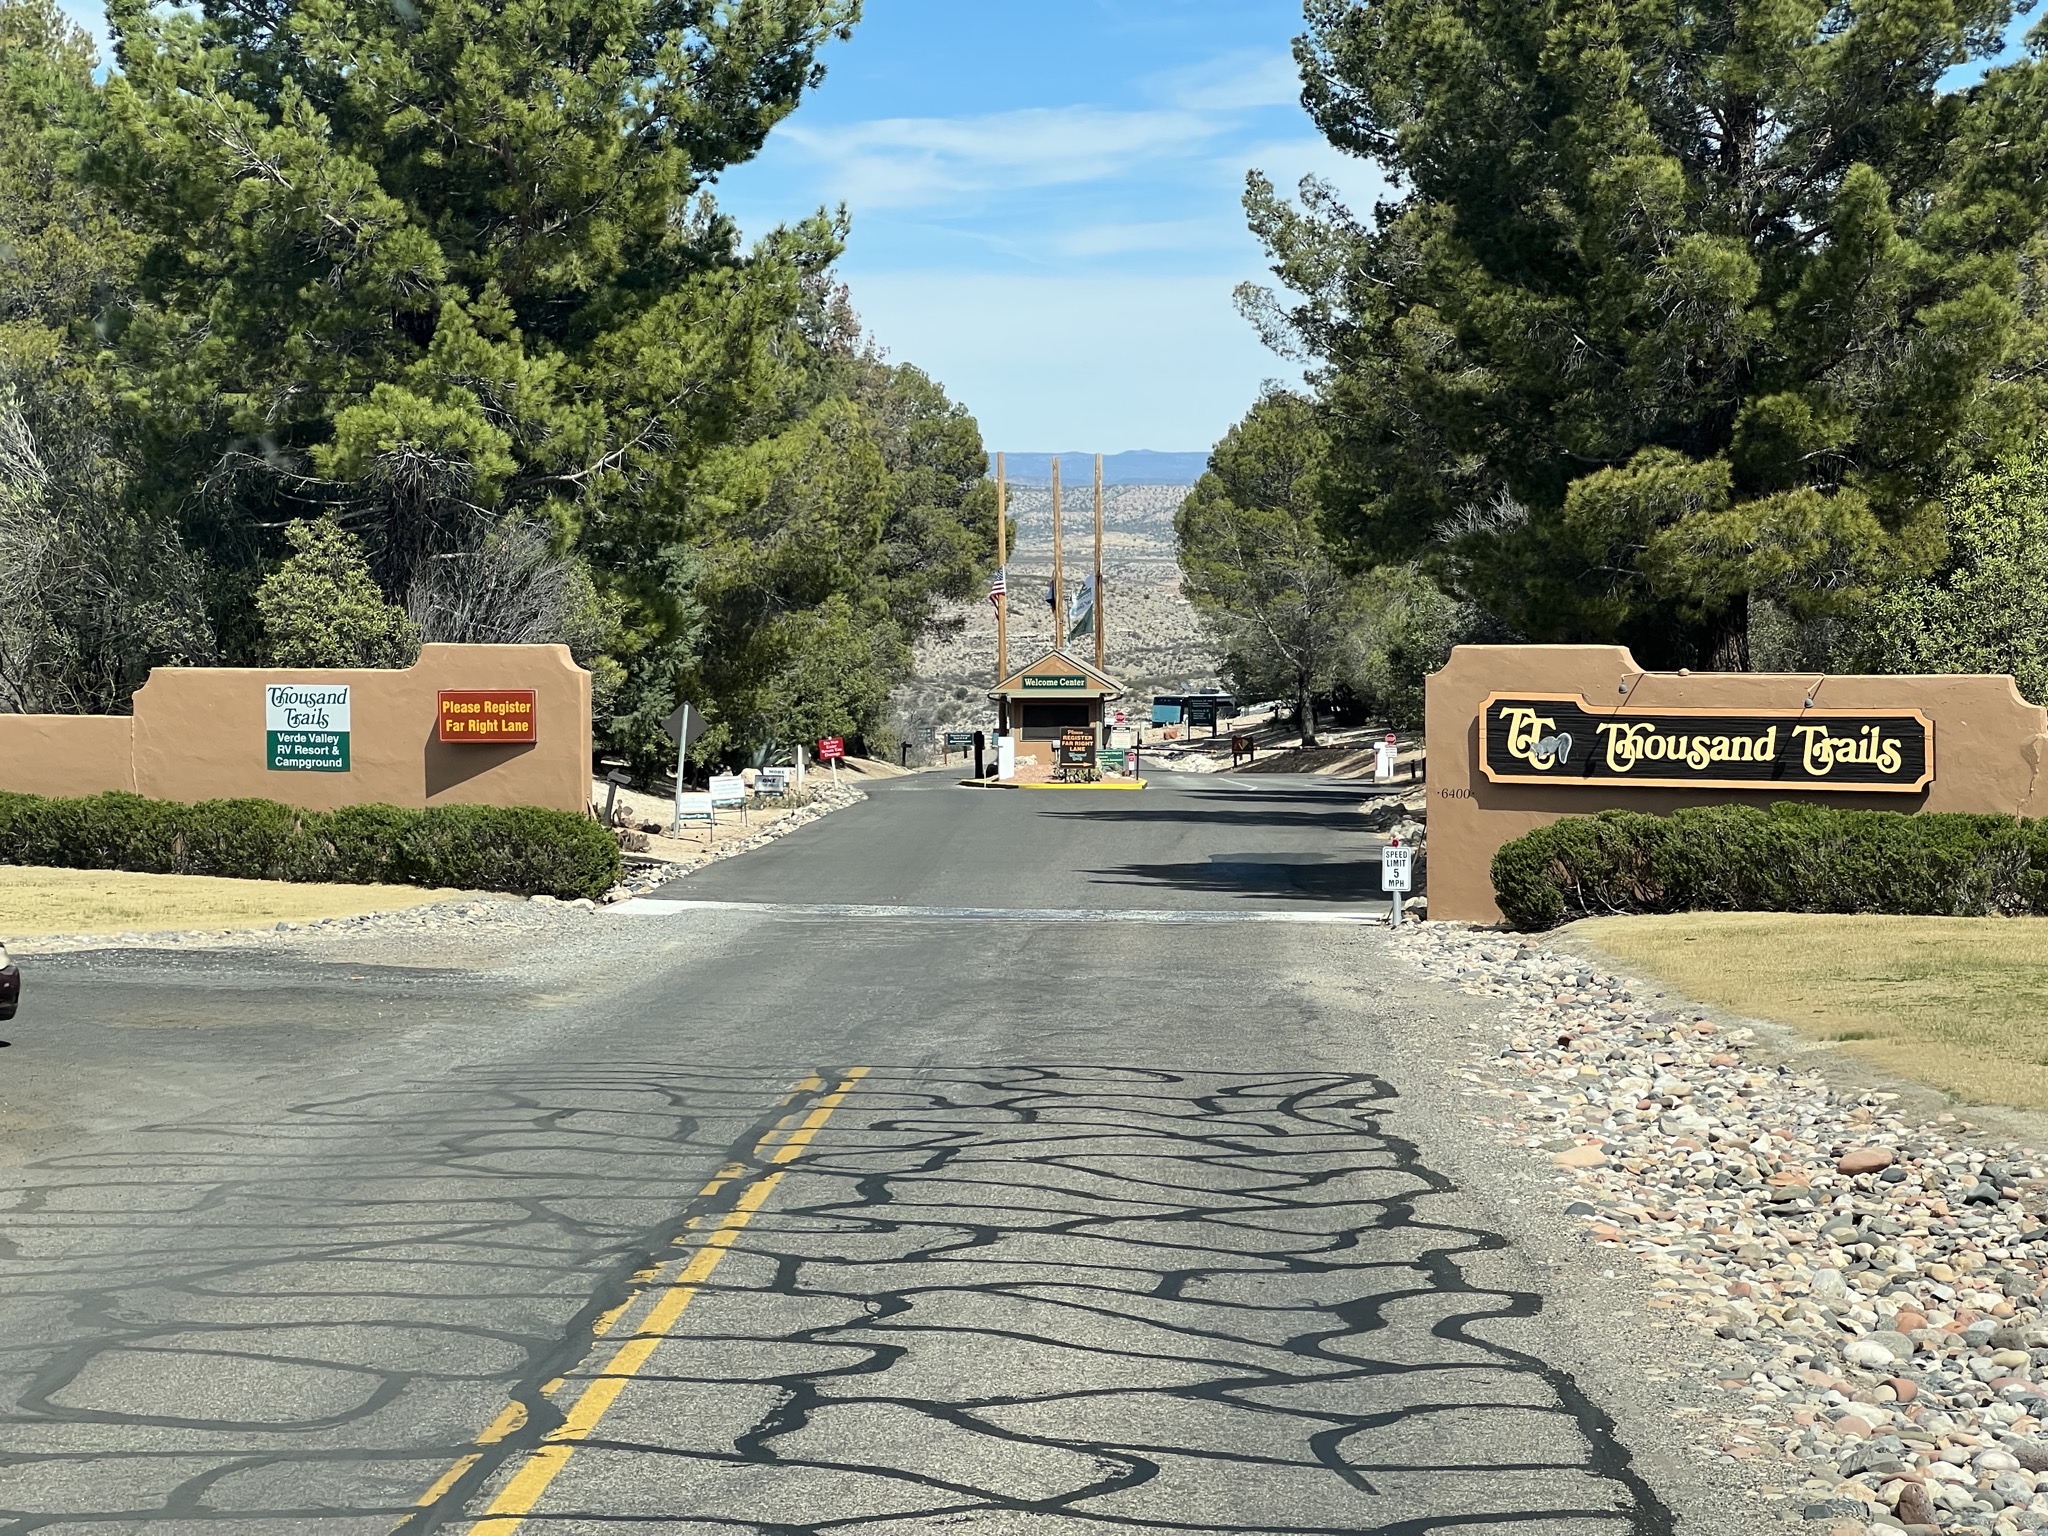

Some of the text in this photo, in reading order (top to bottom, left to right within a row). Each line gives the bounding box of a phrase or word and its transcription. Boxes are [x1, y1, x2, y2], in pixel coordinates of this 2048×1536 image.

[1024, 678, 1085, 686] Welcome Center
[267, 686, 348, 708] Thousand
[442, 701, 531, 716] Please Register
[283, 707, 330, 729] Trails
[445, 719, 529, 734] Far Right Lane
[277, 732, 339, 745] Verde Valley
[277, 745, 340, 756] RV Resort &
[1597, 722, 1902, 776] Thousand Trails
[275, 757, 343, 769] Campground
[1441, 788, 1471, 799] 6400
[1385, 850, 1408, 859] SPEED
[1386, 859, 1406, 867] LIMIT
[1393, 868, 1400, 879] 5
[1388, 879, 1405, 887] MPH
